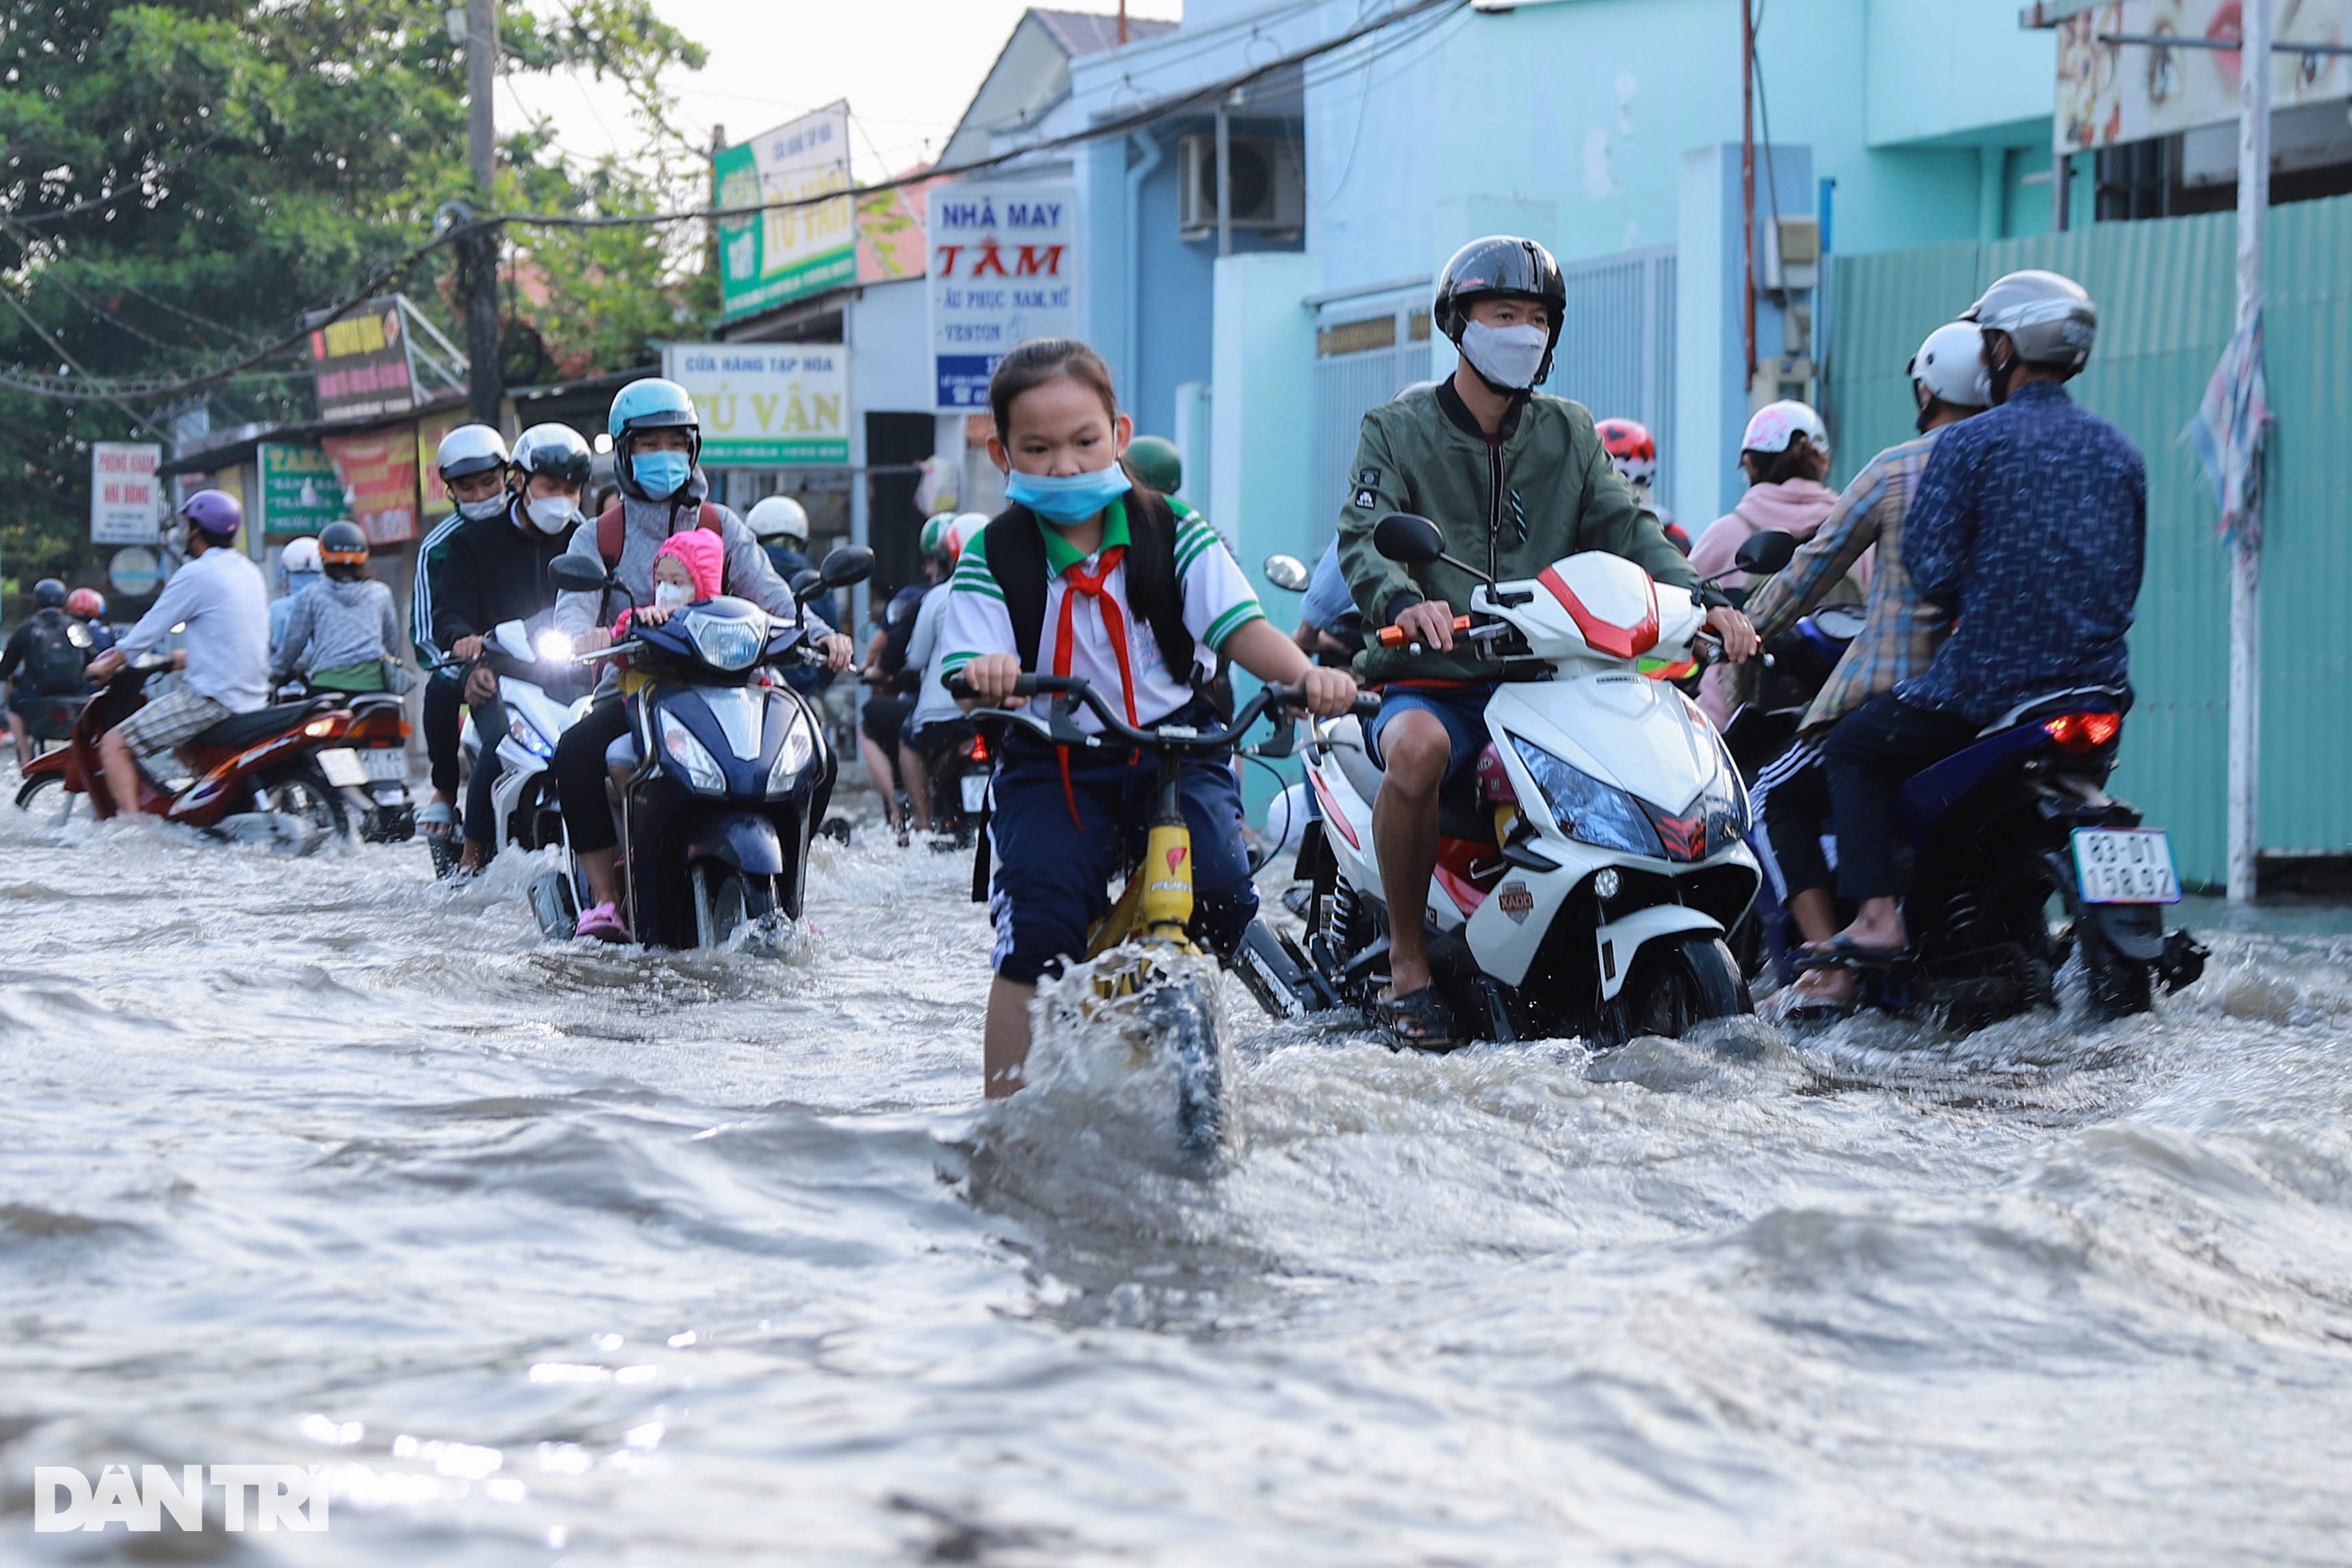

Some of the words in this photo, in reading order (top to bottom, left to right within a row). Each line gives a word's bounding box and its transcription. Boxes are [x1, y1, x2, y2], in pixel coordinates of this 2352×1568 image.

[1008, 203, 1062, 228] MAY
[945, 323, 1001, 342] VESTON
[749, 382, 841, 433] VÂN
